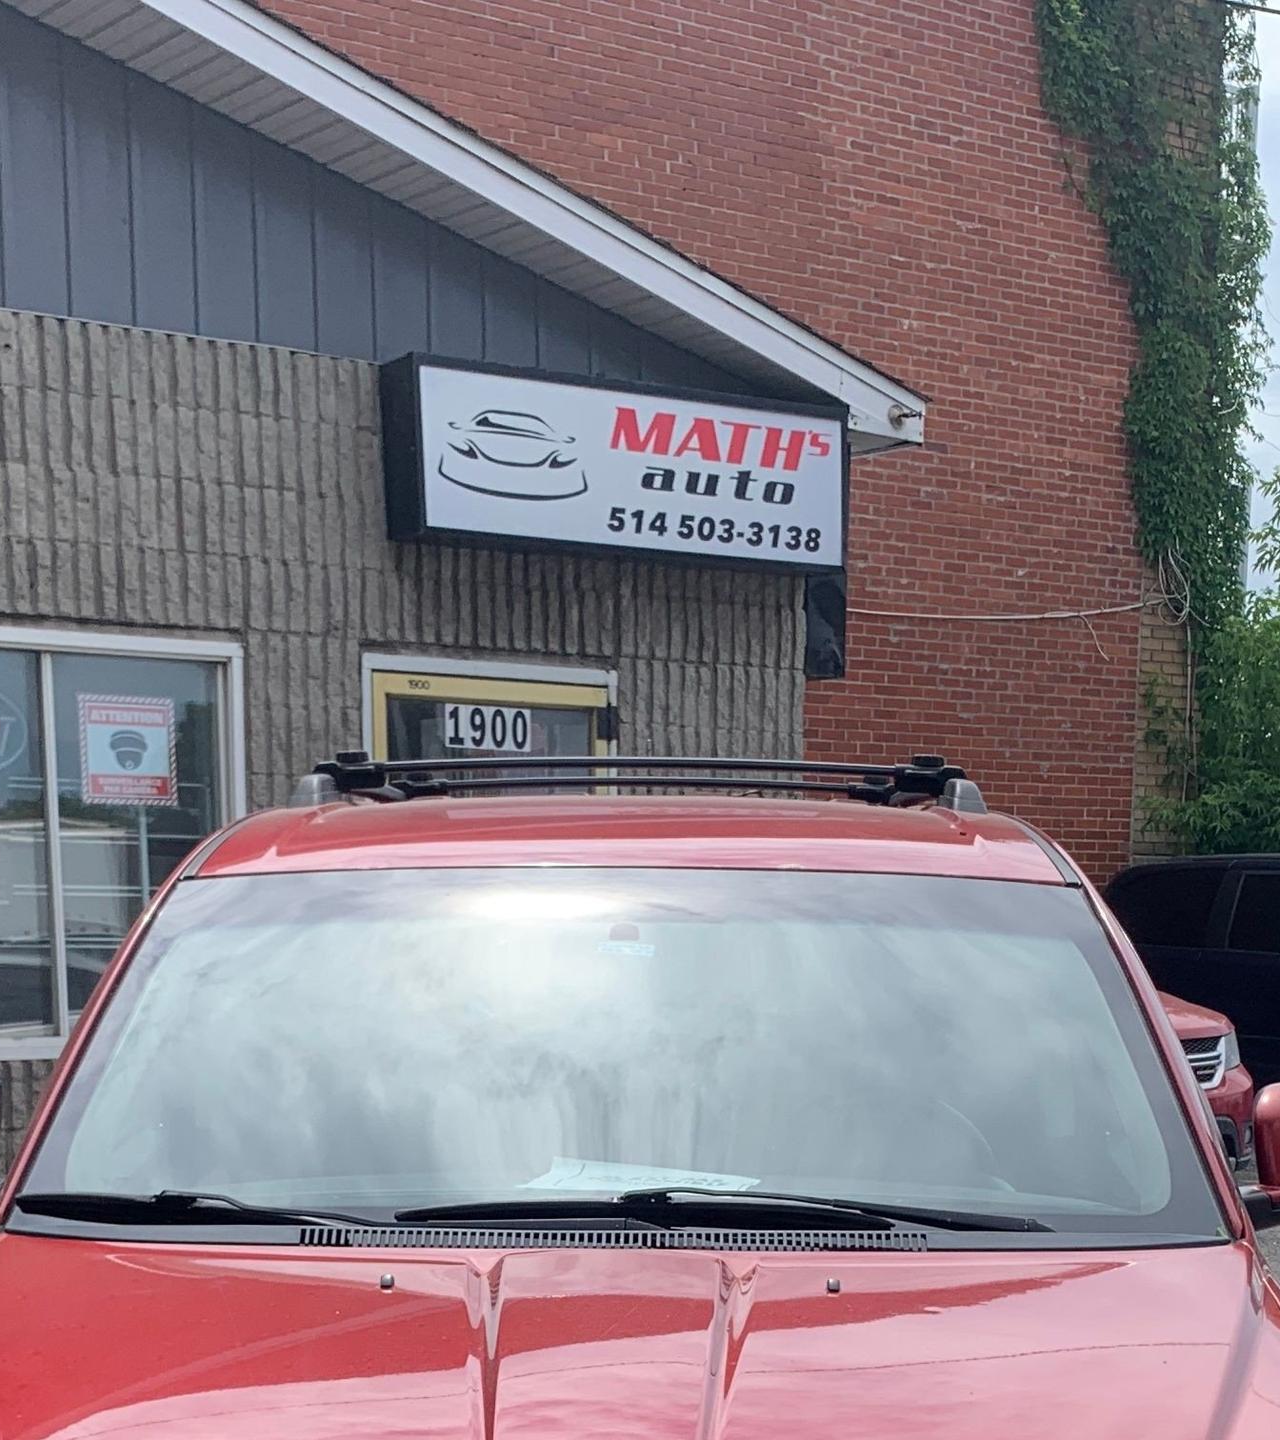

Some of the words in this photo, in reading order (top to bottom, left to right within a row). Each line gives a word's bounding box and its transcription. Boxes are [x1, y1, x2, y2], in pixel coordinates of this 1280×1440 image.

[640, 466, 795, 505] auto
[607, 507, 668, 537] 514
[677, 514, 821, 552] 503-3138
[448, 706, 528, 750] 1900
